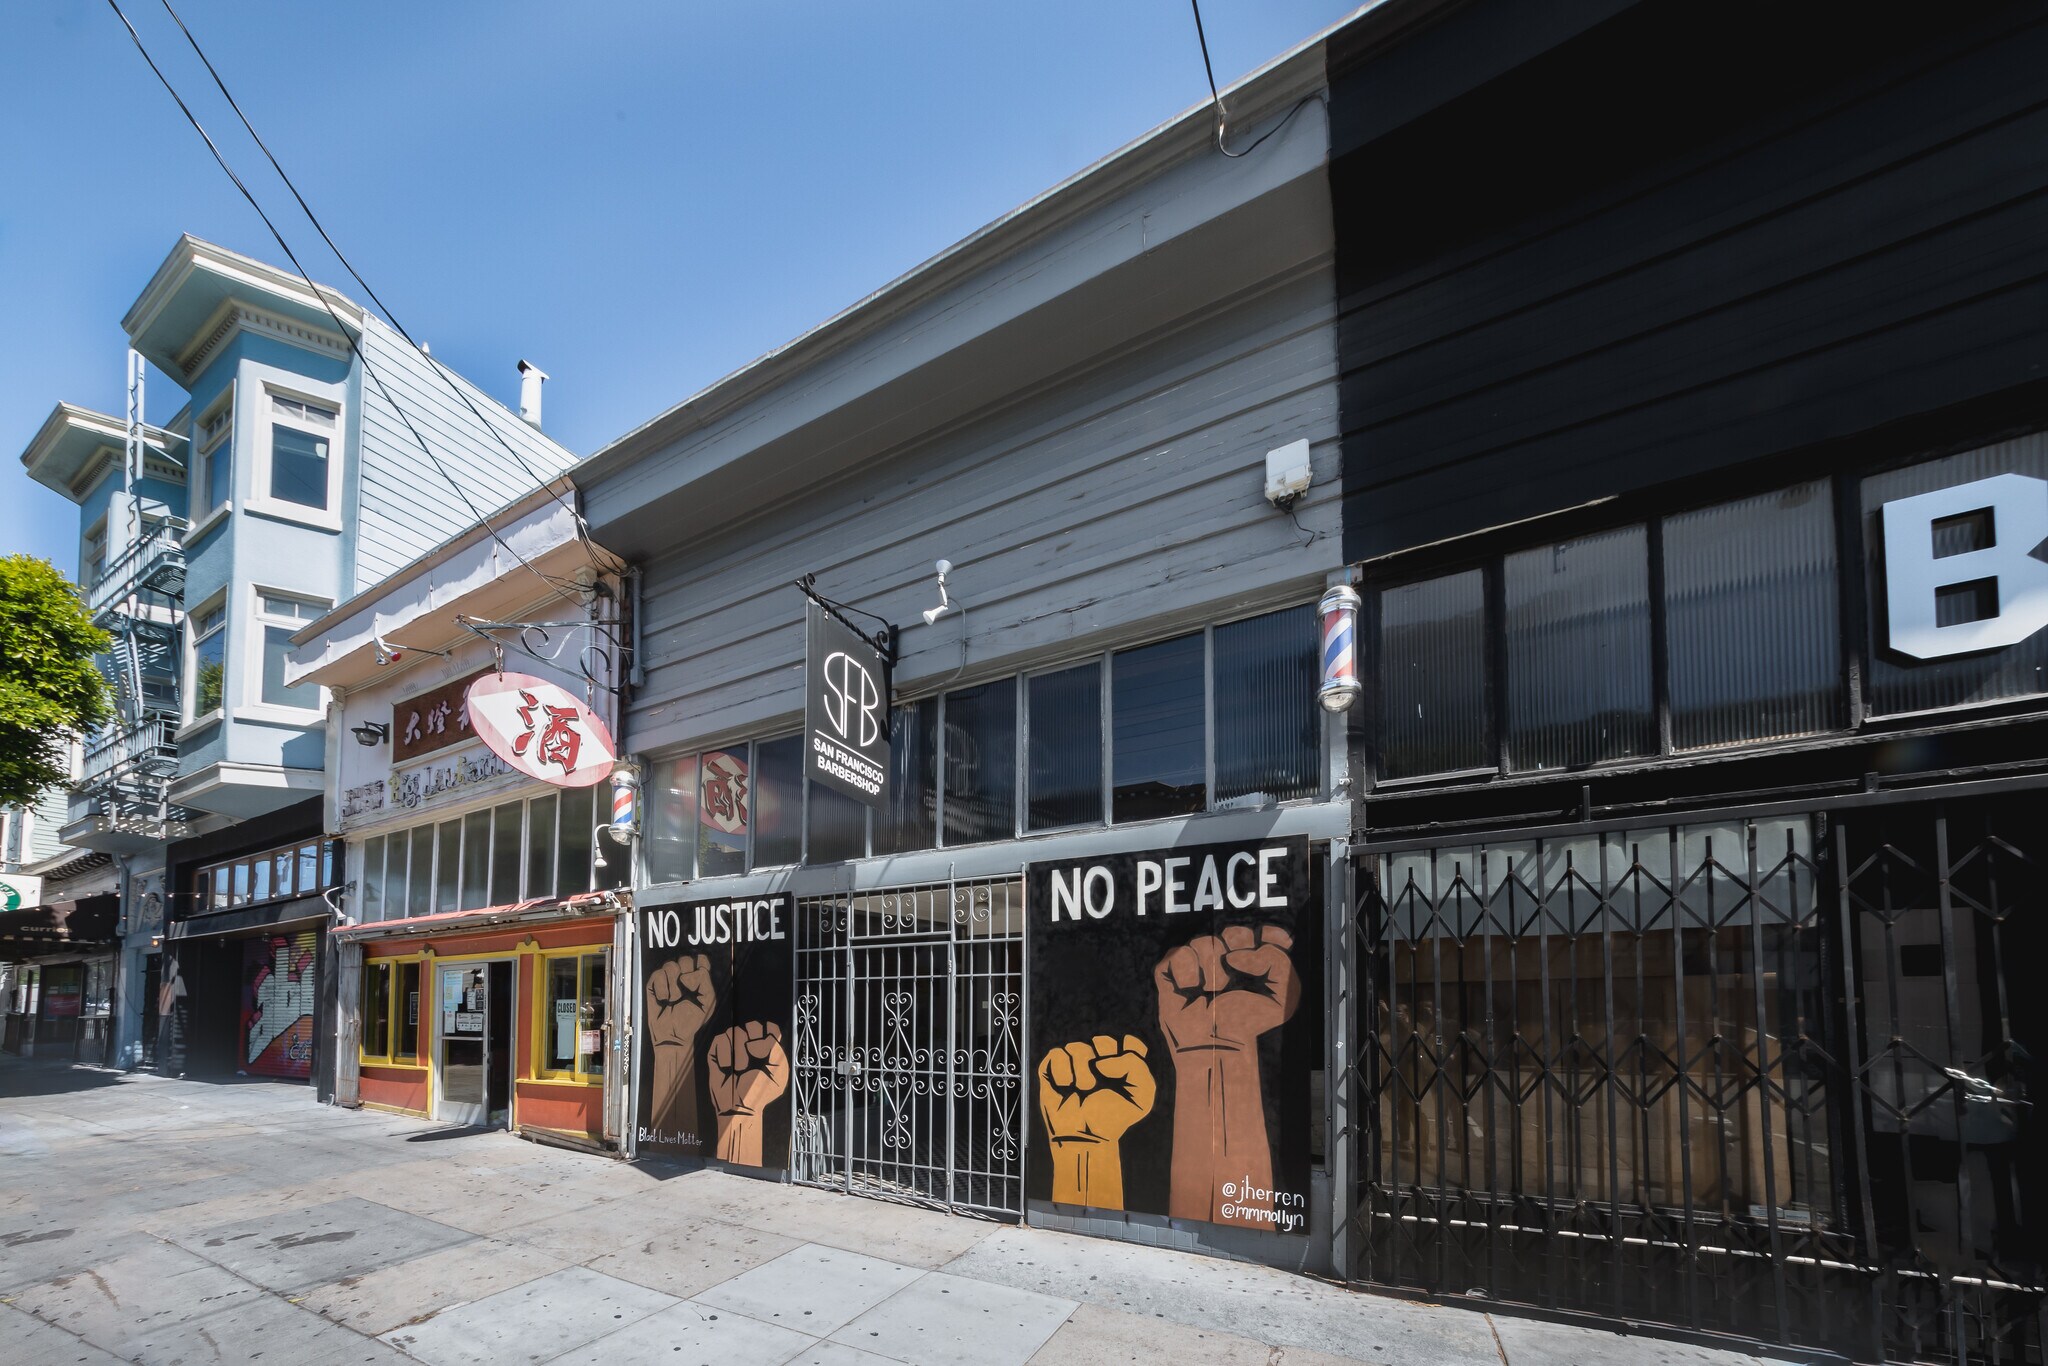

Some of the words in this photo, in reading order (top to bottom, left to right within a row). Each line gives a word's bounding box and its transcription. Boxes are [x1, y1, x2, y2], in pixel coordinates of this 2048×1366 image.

[1883, 473, 2048, 659] B
[824, 652, 879, 747] SFB
[511, 687, 582, 775] 酒
[813, 737, 834, 759] SAN
[836, 749, 884, 785] FRANCISCO
[817, 755, 880, 796] BARBERSHOP
[1051, 866, 1115, 922] NO
[1137, 847, 1288, 916] PEACE
[648, 910, 680, 948] NO
[688, 898, 785, 945] JUSTICE
[557, 1002, 577, 1014] CLOSED
[638, 1126, 658, 1143] Black
[658, 1129, 677, 1144] Lives
[677, 1131, 703, 1146] Matter
[1221, 1174, 1305, 1208] @jherren
[1221, 1203, 1304, 1232] @mmmollyn
